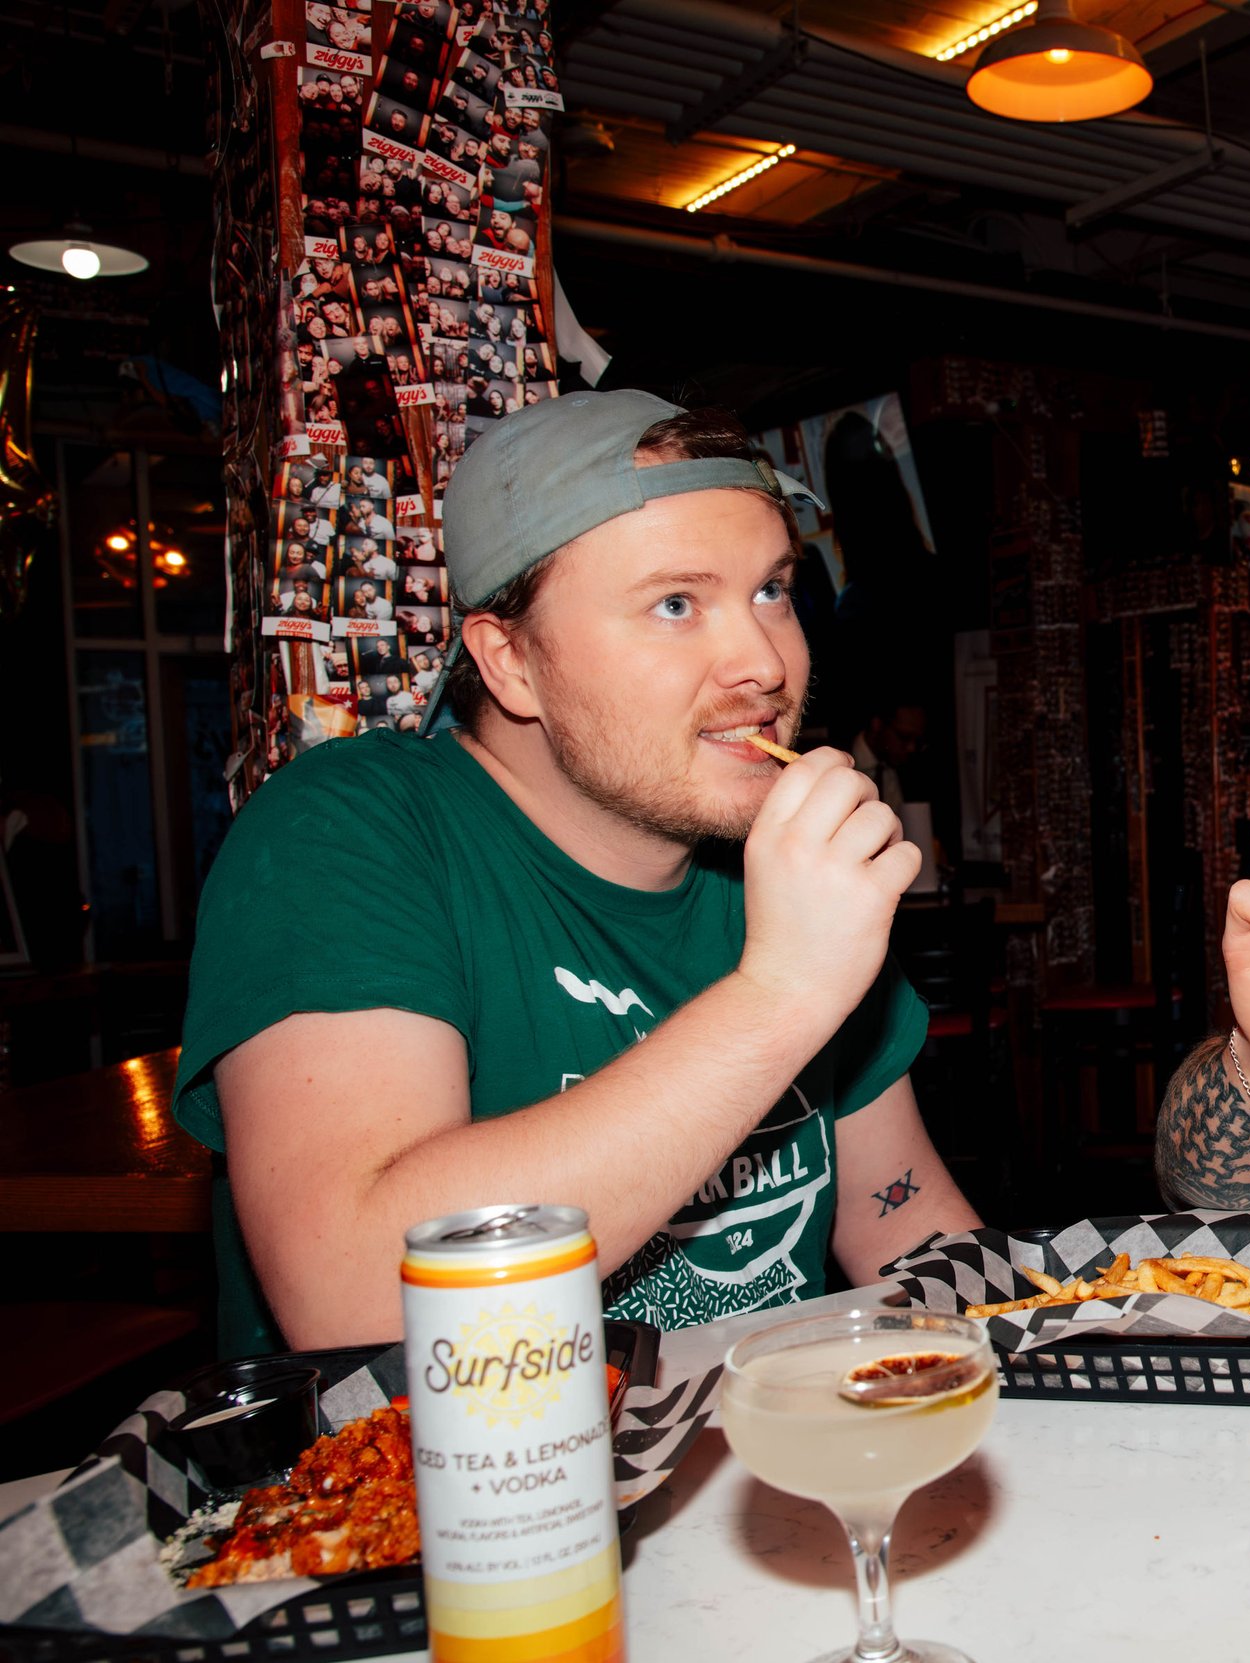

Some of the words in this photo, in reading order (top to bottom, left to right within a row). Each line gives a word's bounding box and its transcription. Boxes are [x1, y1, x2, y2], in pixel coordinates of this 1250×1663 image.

[314, 48, 364, 71] ziggy's
[367, 137, 416, 163] ziggy's
[423, 154, 467, 184] ziggy's
[313, 239, 339, 259] zig
[477, 250, 525, 271] ziggy's
[806, 1109, 900, 1141] NTA
[424, 1323, 595, 1393] Surfside
[453, 1453, 495, 1471] TEA
[504, 1451, 519, 1469] &
[490, 1466, 568, 1496] VODKA
